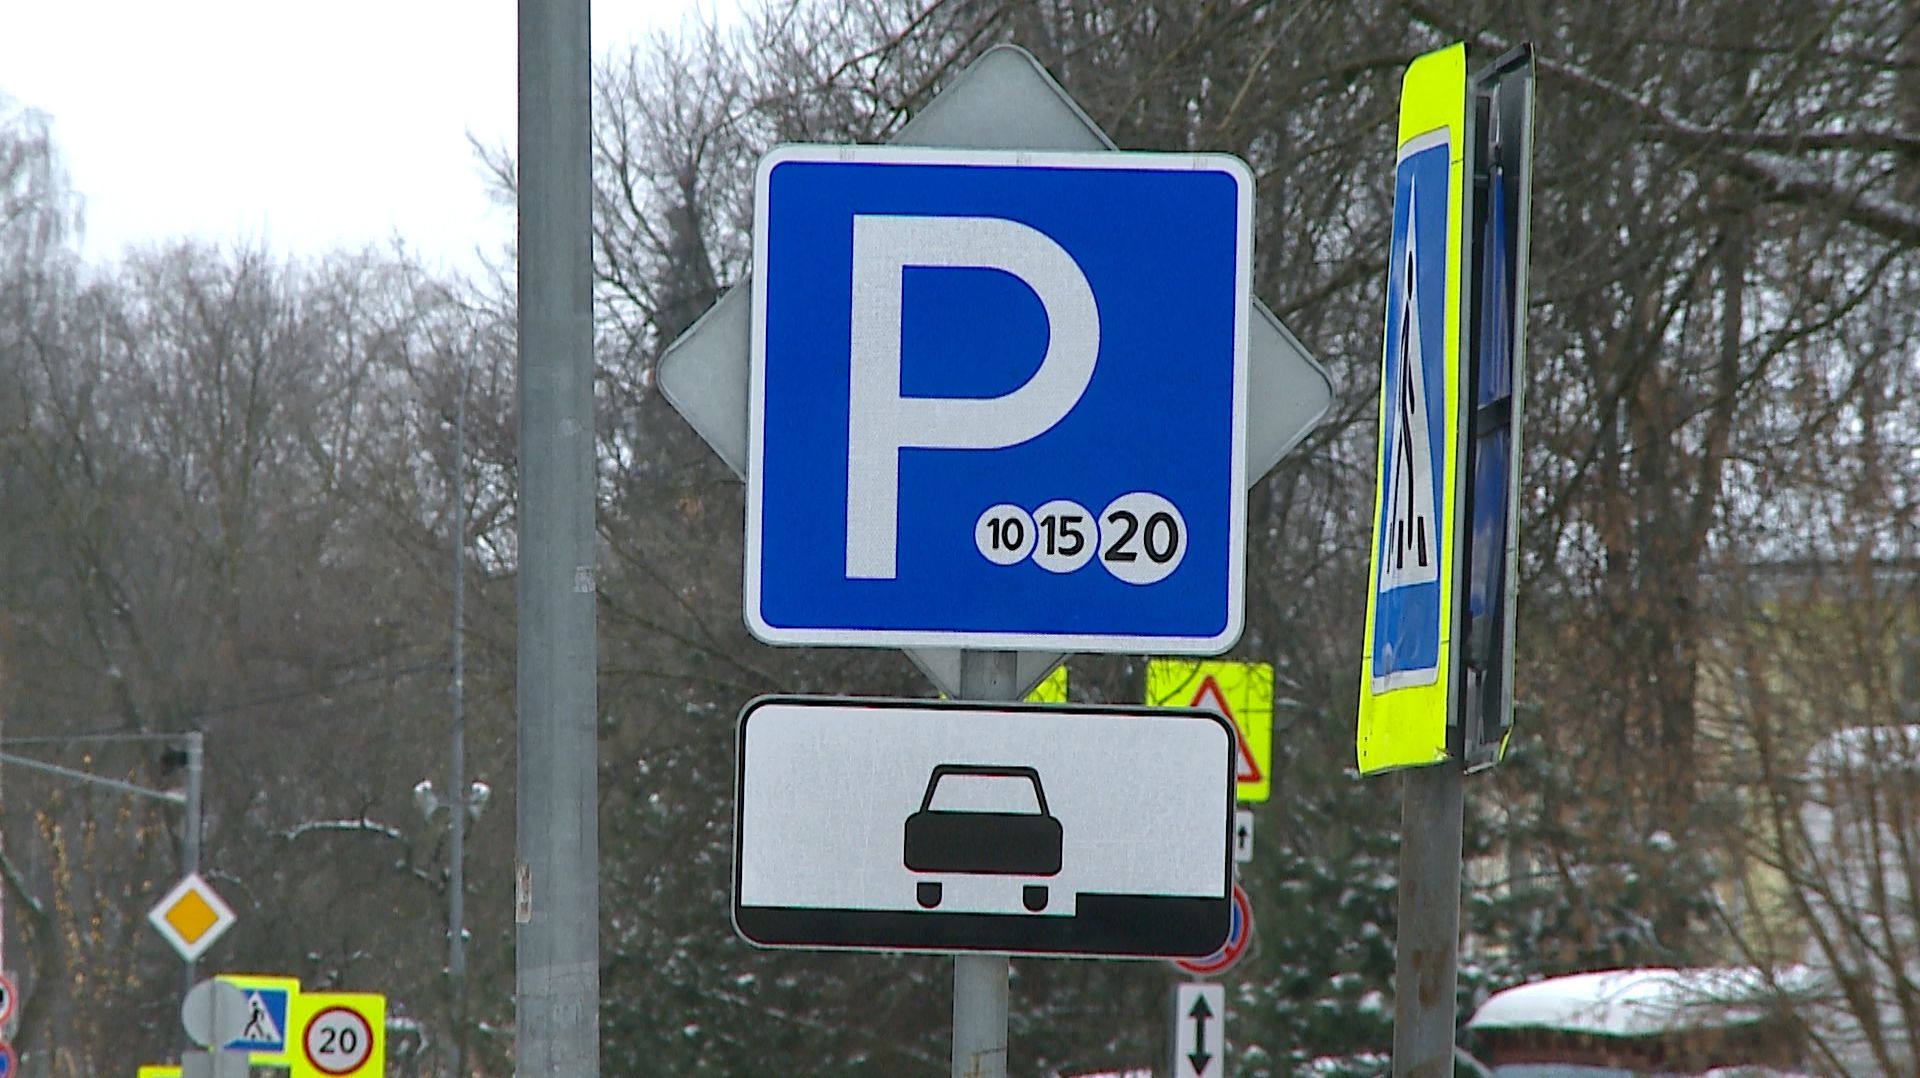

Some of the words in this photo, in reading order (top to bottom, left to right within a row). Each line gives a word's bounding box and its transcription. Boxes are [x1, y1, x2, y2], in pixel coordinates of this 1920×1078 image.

[845, 214, 1101, 580] P
[987, 517, 1024, 551] 10
[1040, 515, 1085, 556] 15
[1105, 510, 1179, 563] 20
[319, 1027, 357, 1054] 20
